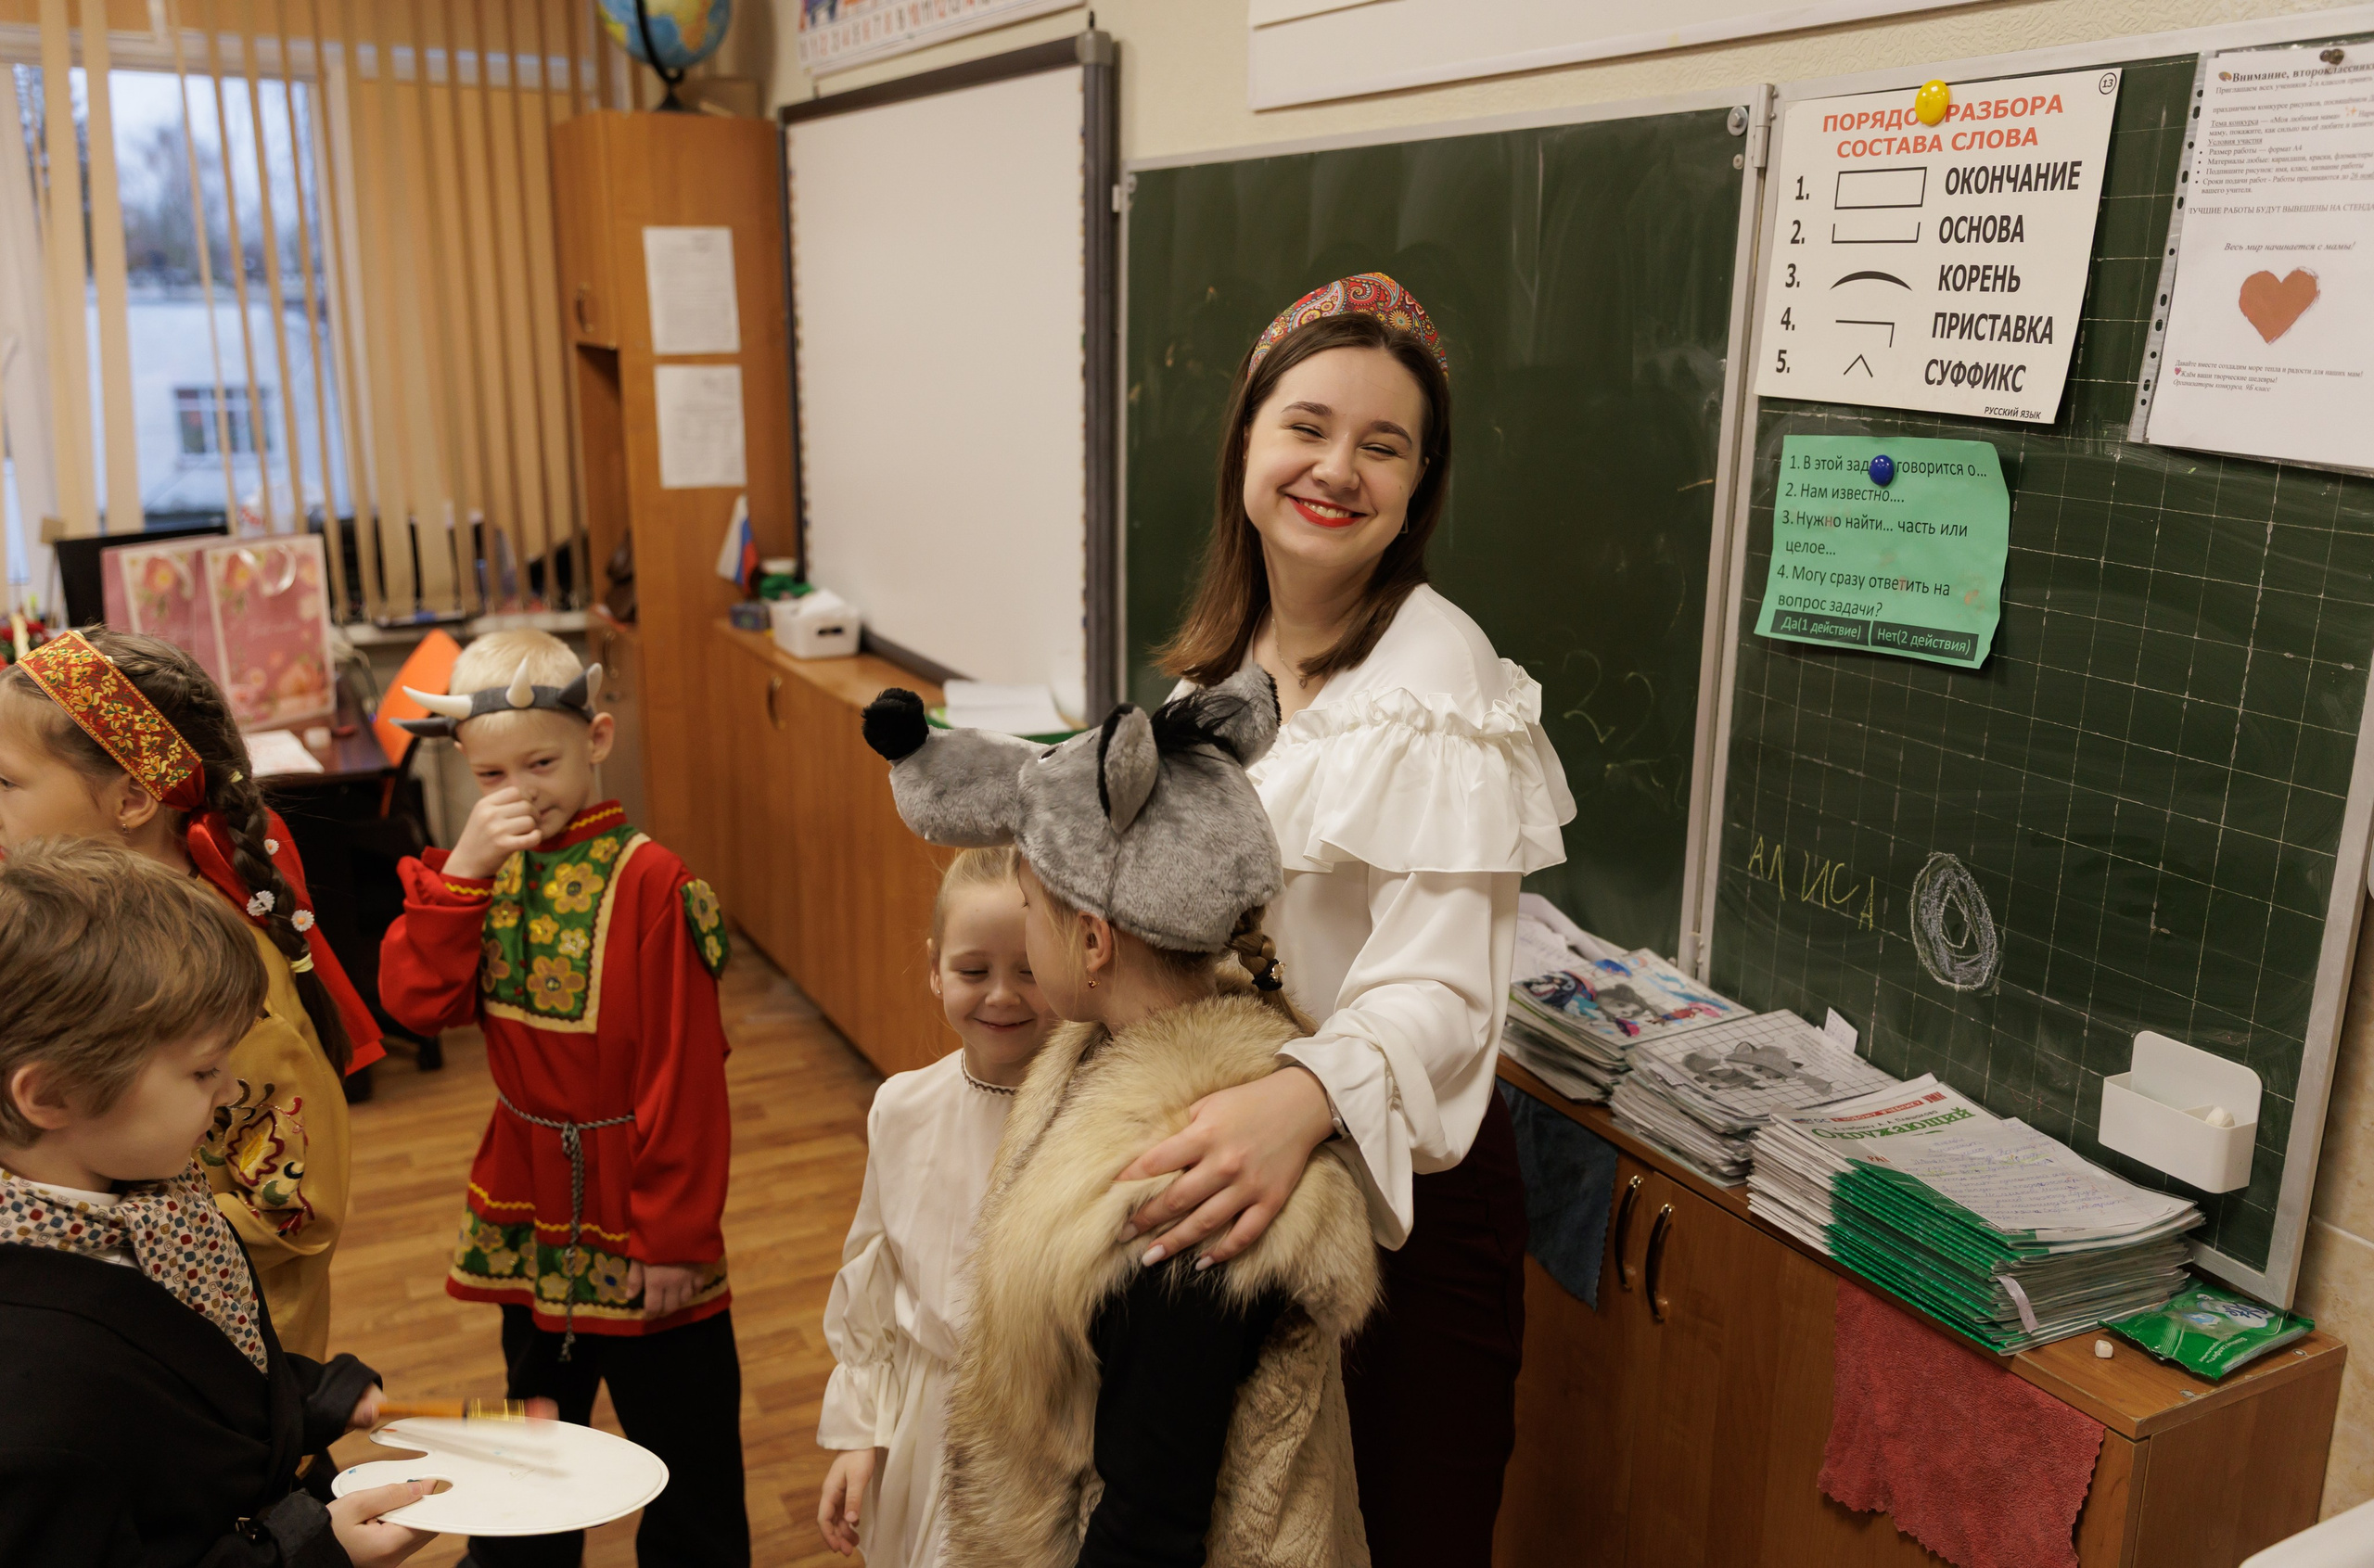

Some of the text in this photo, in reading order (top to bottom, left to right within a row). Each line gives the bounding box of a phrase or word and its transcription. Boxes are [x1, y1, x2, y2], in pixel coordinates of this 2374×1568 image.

[2101, 78, 2114, 90] 13
[2232, 71, 2290, 83] Внимание,
[2215, 84, 2257, 95] Приглашаем
[1822, 94, 2063, 133] ПОРЯДО РАЗБОРА
[2210, 120, 2227, 128] Тема
[1836, 127, 2038, 159] СОСТАВА СЛОВА
[2207, 138, 2236, 147] Условия
[2209, 148, 2232, 157] Размер
[2233, 147, 2257, 156] работы
[2267, 146, 2291, 155] формат
[2207, 158, 2245, 166] Материалы
[1795, 160, 2082, 200] 1. ОКОНЧАНИЕ
[2202, 177, 2224, 185] Сроки
[2249, 175, 2266, 184] работ
[2272, 174, 2295, 184] Работы
[2223, 206, 2254, 214] РАБОТЫ
[2255, 205, 2281, 214] БУДУТ
[2282, 204, 2328, 213] ВЫВЕШЕНЫ
[2329, 203, 2341, 211] НА
[1790, 214, 2024, 245] 2. ОСНОВА
[2224, 242, 2243, 251] Весь
[2245, 243, 2263, 252] мир
[2265, 243, 2316, 251] начинается
[2324, 241, 2356, 251] мамы!
[1785, 263, 2021, 293] 3. КОРЕНЬ
[1780, 307, 2054, 345] 4. ПРИСТАВКА
[1776, 350, 2026, 393] 5. СУФФИКС
[1984, 405, 2042, 420] РУССКИЙ ЯЗЫК
[1790, 455, 1801, 470] 1.
[1804, 455, 1811, 470] В
[1815, 455, 1843, 471] этой
[1846, 457, 1870, 475] зад
[1896, 460, 1964, 478] говорится
[1785, 482, 1797, 497] 2.
[1800, 483, 1828, 499] Нам
[1781, 510, 1968, 538] 3. Нужно найти... часть или
[1785, 540, 1836, 556] целое...
[1777, 564, 1950, 596] 4. Могу сразу ответить на
[1778, 594, 1883, 618] вопрос задачи?
[1810, 619, 1861, 641] действие)
[1910, 634, 1972, 656] действия)
[1748, 835, 1874, 932] АЛИСА
[1811, 1106, 1976, 1141] Окружающий
